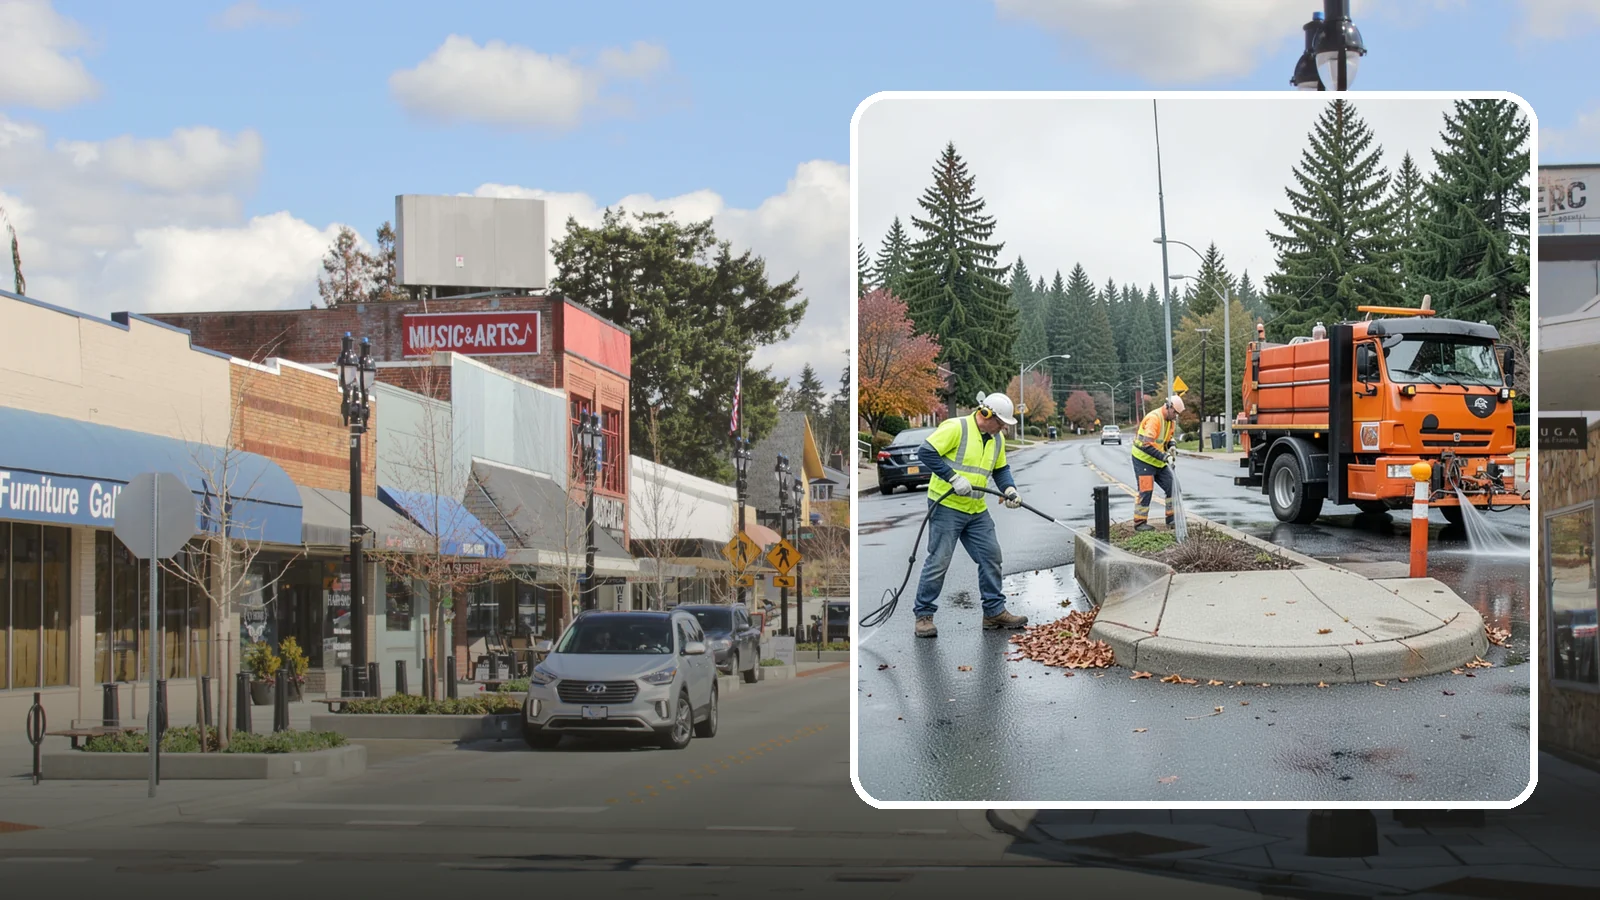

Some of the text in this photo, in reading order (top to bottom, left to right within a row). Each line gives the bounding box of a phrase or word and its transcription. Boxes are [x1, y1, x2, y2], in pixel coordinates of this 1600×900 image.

[409, 323, 519, 349] MUSIC&ARTS
[1540, 427, 1577, 436] UGA
[0, 472, 122, 519] Furniture Gal
[452, 563, 480, 574] SUSHI
